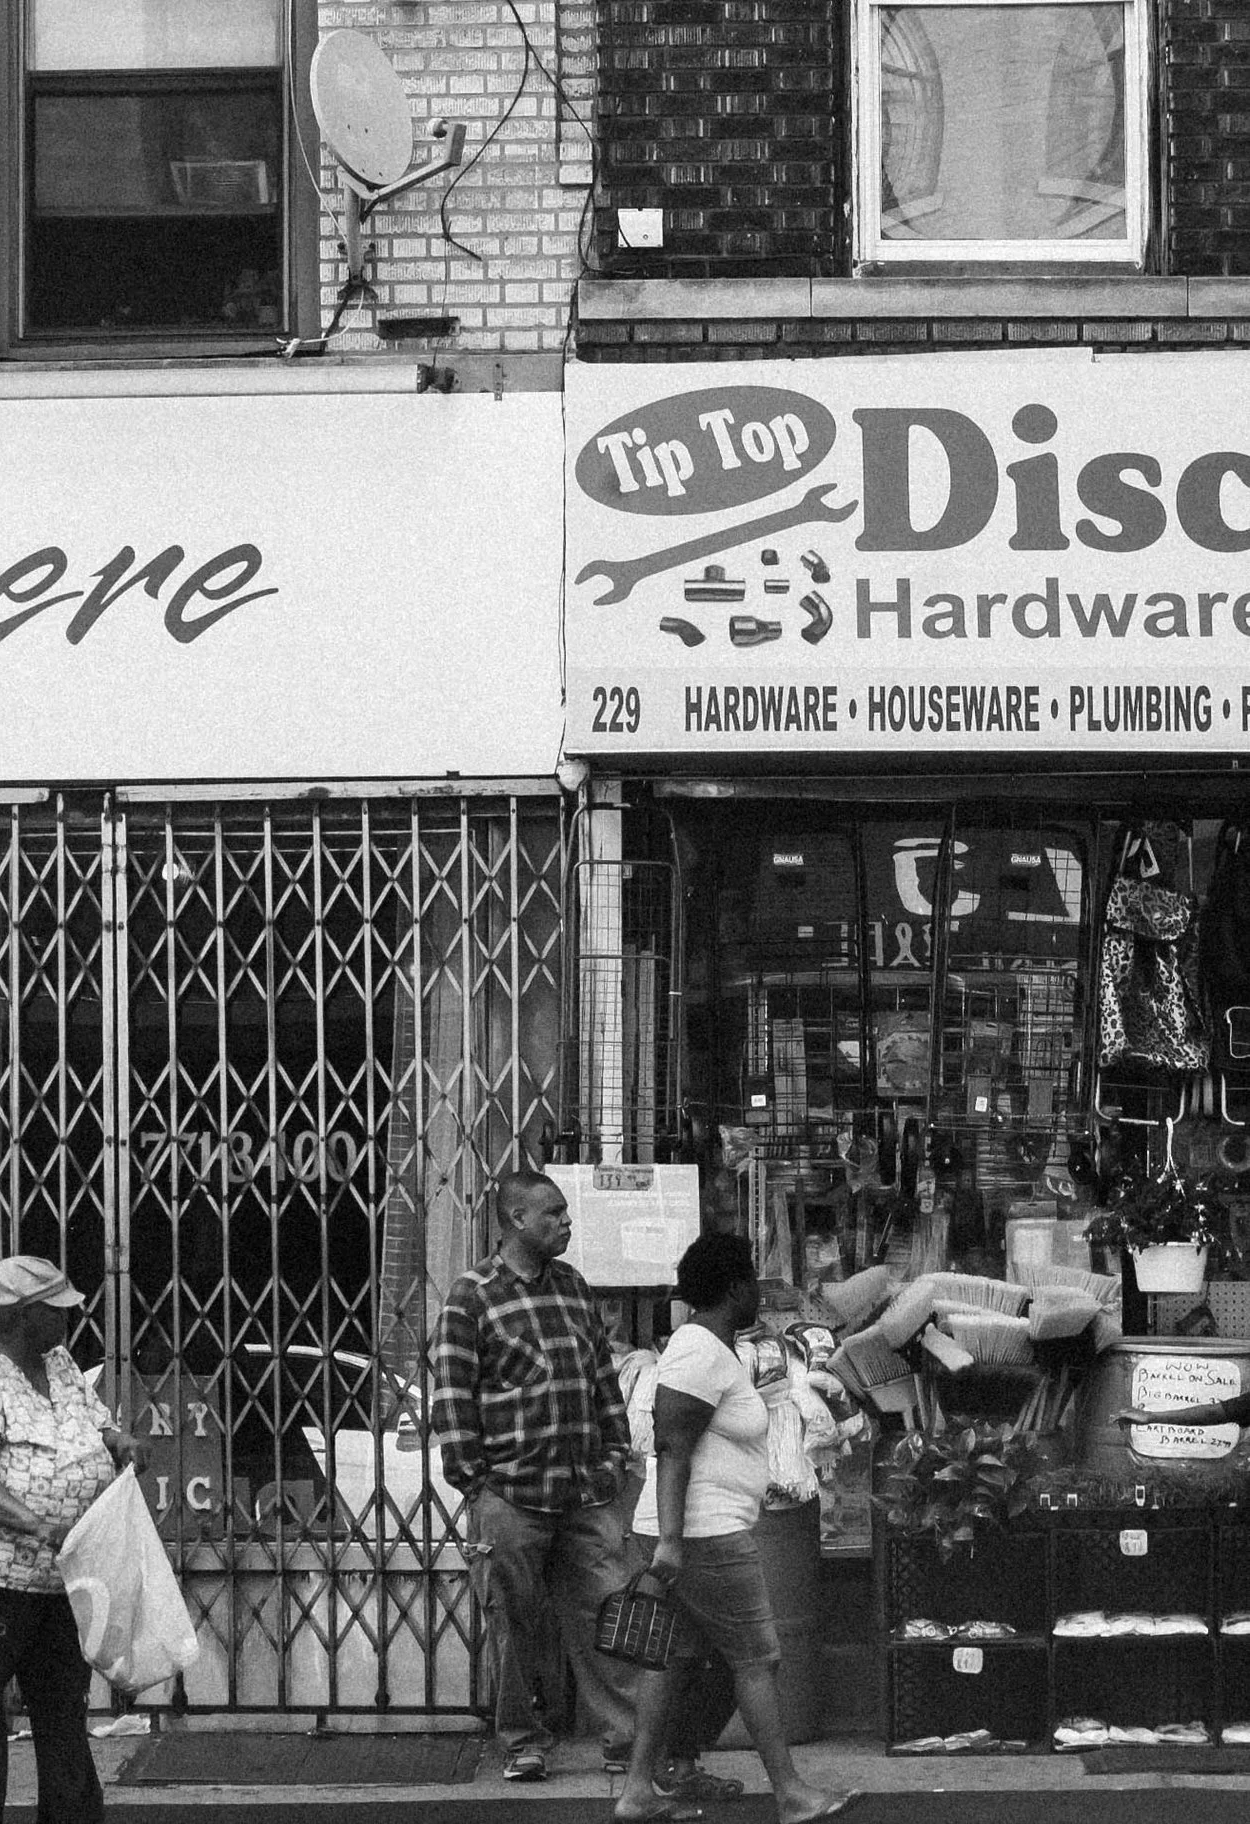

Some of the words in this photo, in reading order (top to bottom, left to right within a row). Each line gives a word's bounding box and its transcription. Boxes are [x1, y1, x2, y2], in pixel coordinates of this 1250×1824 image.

[597, 427, 694, 497] Tip
[699, 408, 810, 471] Top
[592, 686, 641, 734] 229
[685, 685, 838, 733] HARDWARE
[868, 685, 1040, 733] HOUSEWARE
[1070, 685, 1212, 733] PLUMBING
